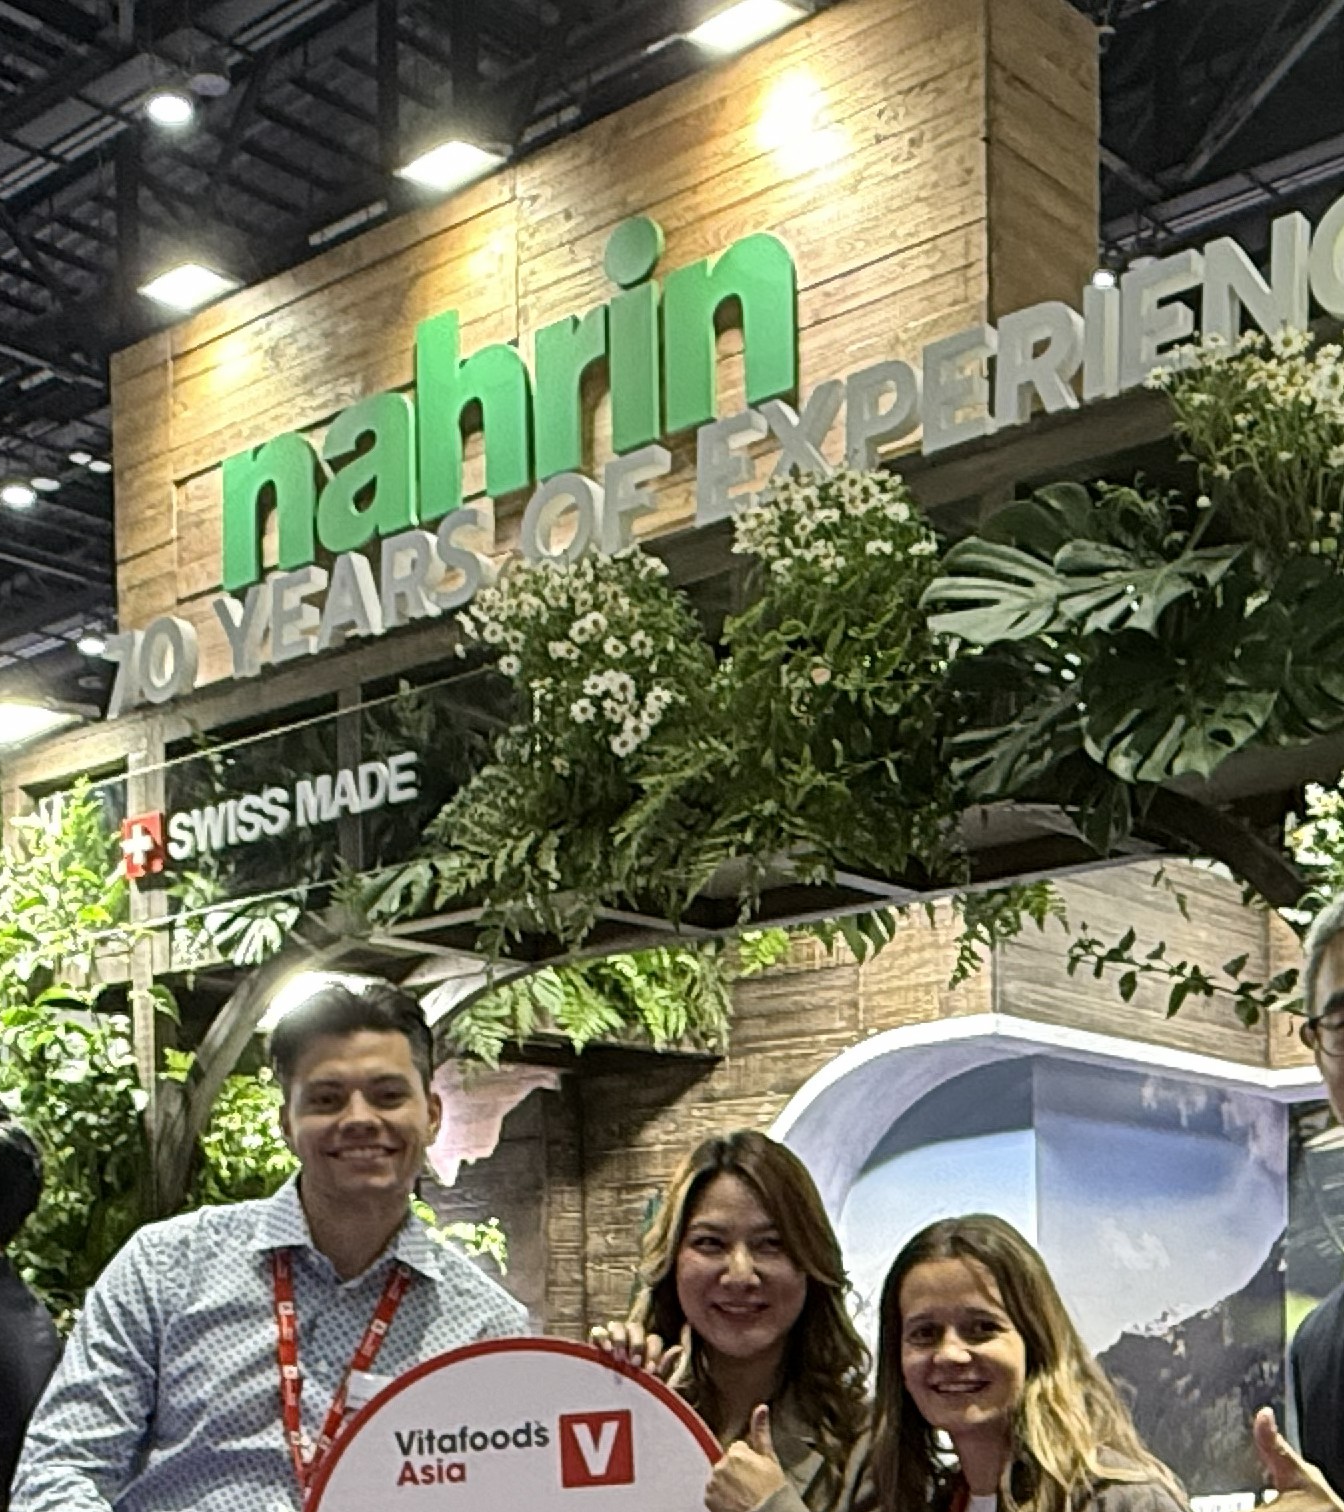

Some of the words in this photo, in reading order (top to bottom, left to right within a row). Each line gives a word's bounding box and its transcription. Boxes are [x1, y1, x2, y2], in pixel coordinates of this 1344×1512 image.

[222, 216, 798, 592] nahrin
[213, 496, 494, 680] YEARS
[522, 445, 672, 565] OF
[167, 787, 292, 860] SWISS
[296, 751, 419, 827] MADE
[394, 1421, 551, 1456] Vitafoods
[396, 1458, 467, 1487] Asia
